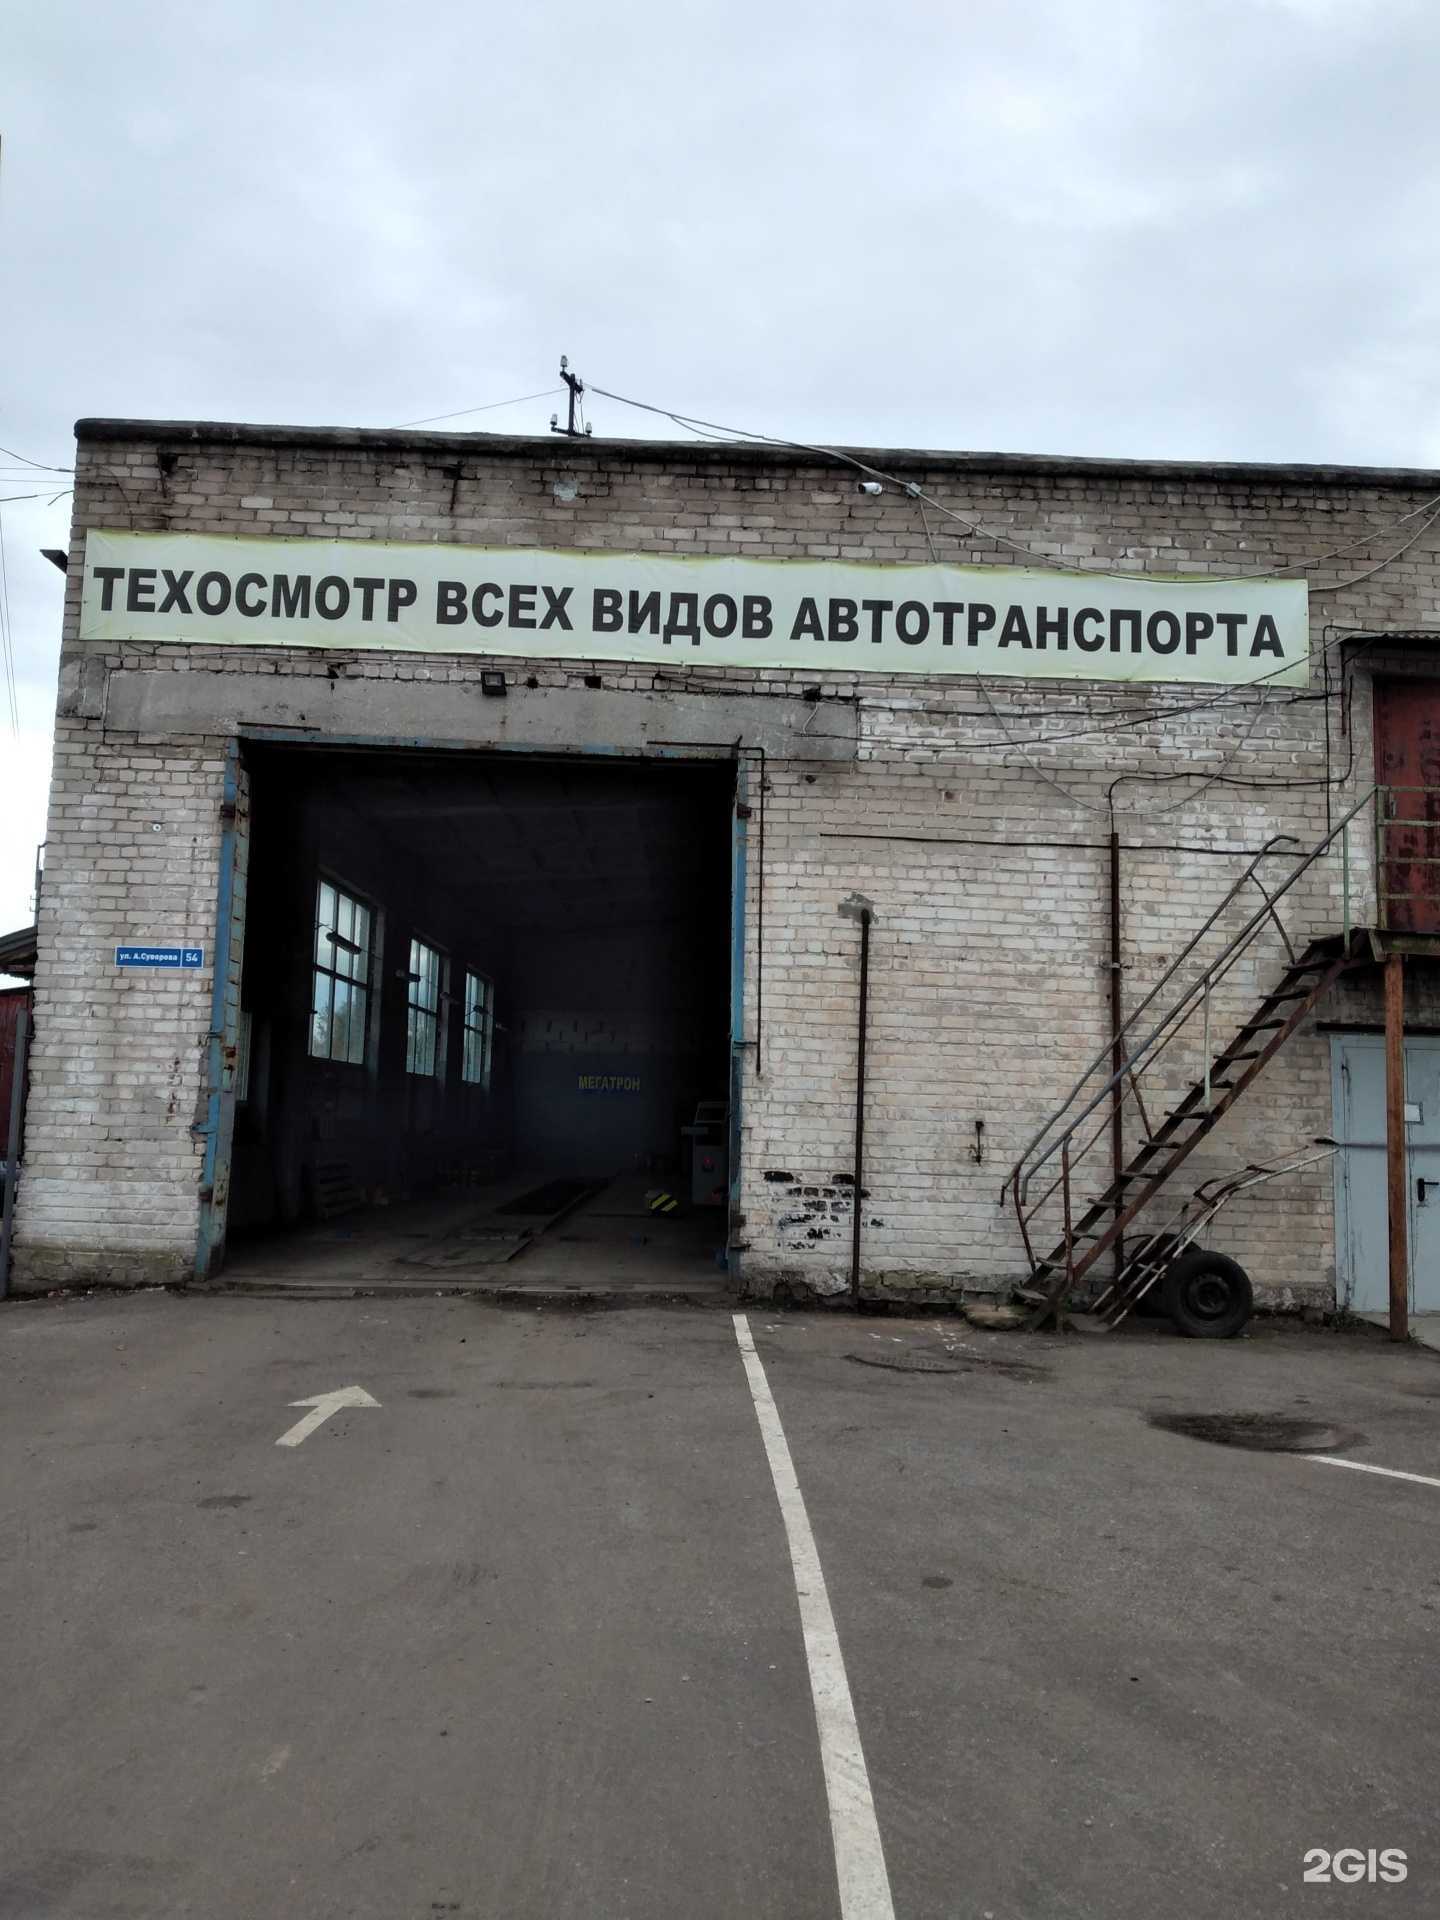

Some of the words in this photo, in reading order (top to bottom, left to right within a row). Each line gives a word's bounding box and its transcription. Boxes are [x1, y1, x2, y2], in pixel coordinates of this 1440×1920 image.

[93, 566, 418, 623] ТЕХОСМОТР
[436, 581, 574, 631] ВСЕХ
[592, 588, 773, 646] ВИДОВ
[789, 597, 1285, 658] АВТОТРАНСПОРТА
[119, 952, 131, 961] ул.
[185, 953, 199, 962] 54
[578, 1075, 641, 1091] МЕГАТРОН
